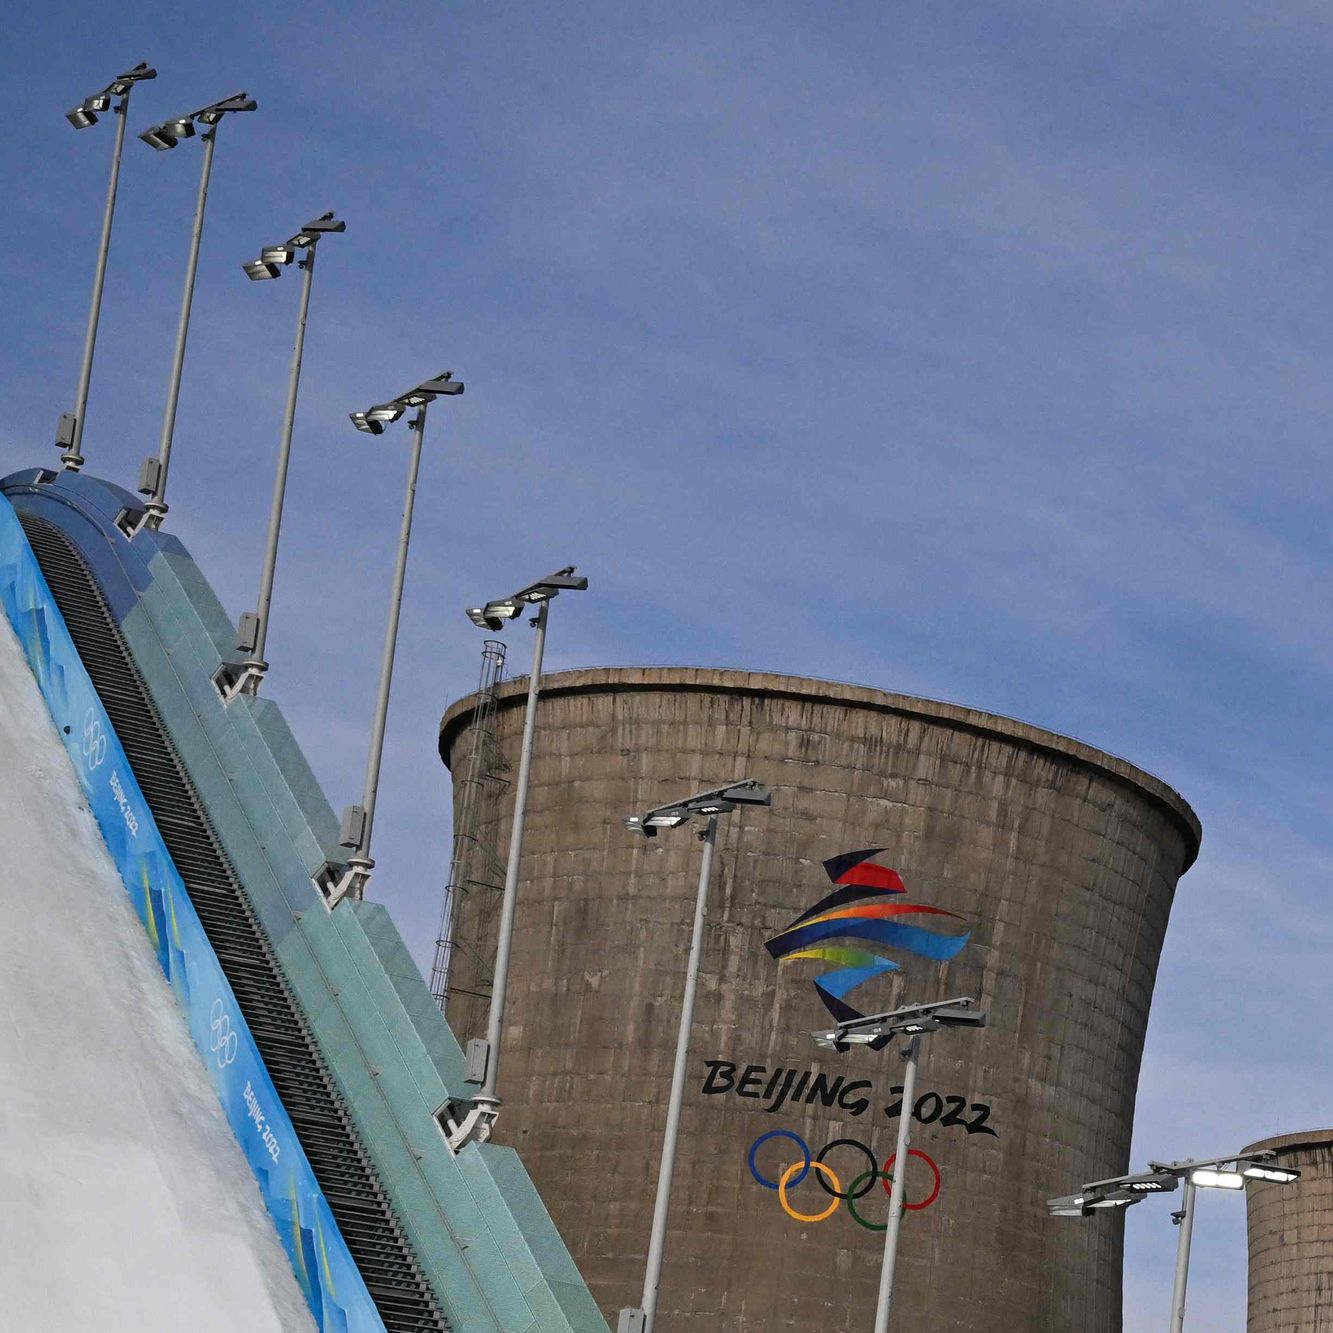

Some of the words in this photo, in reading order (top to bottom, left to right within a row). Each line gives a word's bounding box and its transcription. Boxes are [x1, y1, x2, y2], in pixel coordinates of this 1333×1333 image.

[243, 1080, 265, 1132] BEIJING
[262, 1124, 280, 1165] 2022
[702, 1060, 871, 1116] BEIJING
[884, 1085, 999, 1138] 2022
